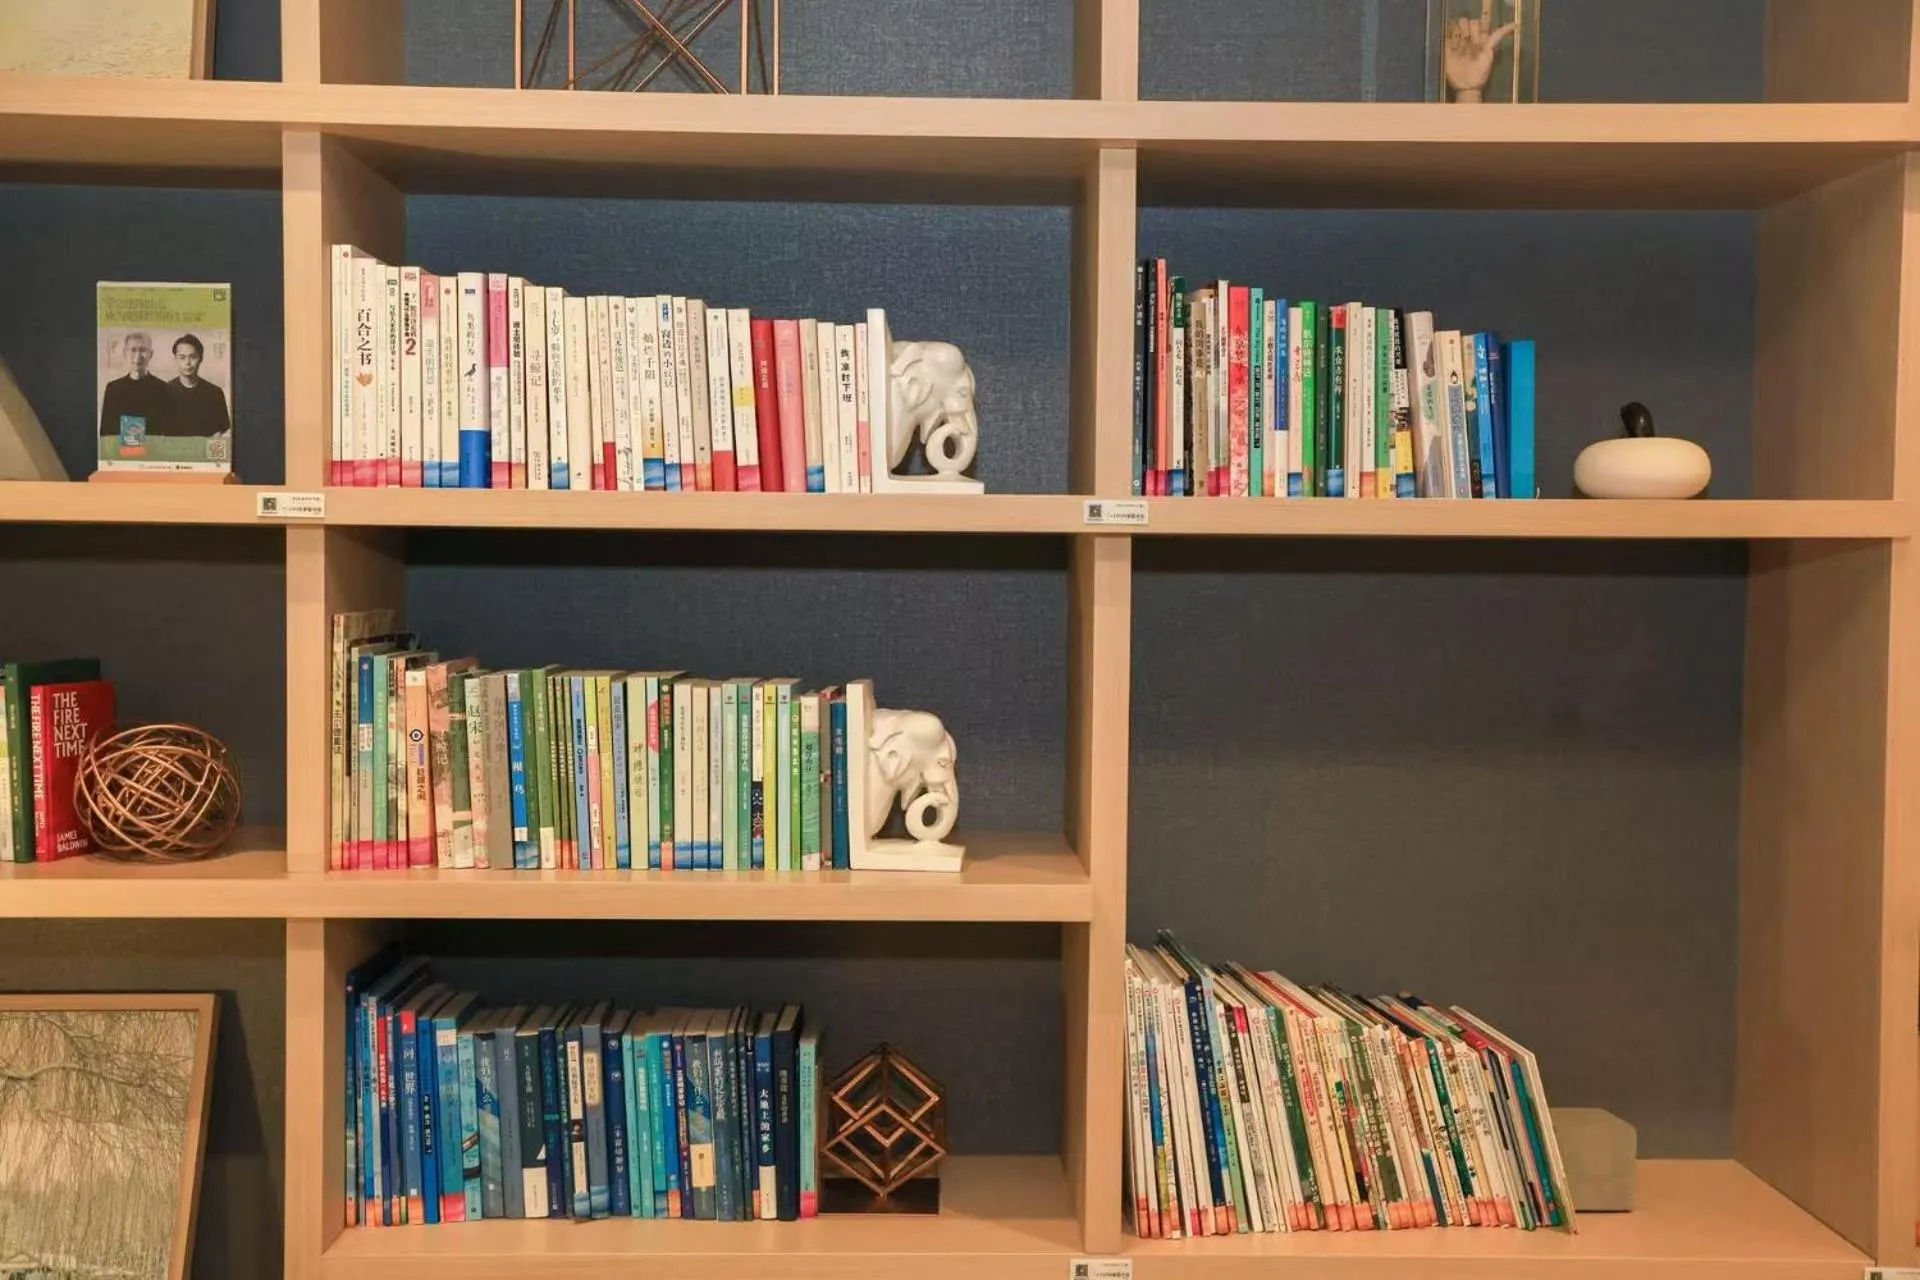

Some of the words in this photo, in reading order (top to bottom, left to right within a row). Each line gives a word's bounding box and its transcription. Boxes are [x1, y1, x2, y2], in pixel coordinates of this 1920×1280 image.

[356, 307, 372, 366] 百合之书
[405, 337, 416, 356] 2
[52, 691, 78, 708] THE
[54, 708, 80, 725] FIRE
[54, 722, 88, 742] NEXT
[57, 830, 78, 842] JAMES
[57, 837, 88, 852] BALDWIN
[758, 1088, 772, 1154] 大地上的家乡
